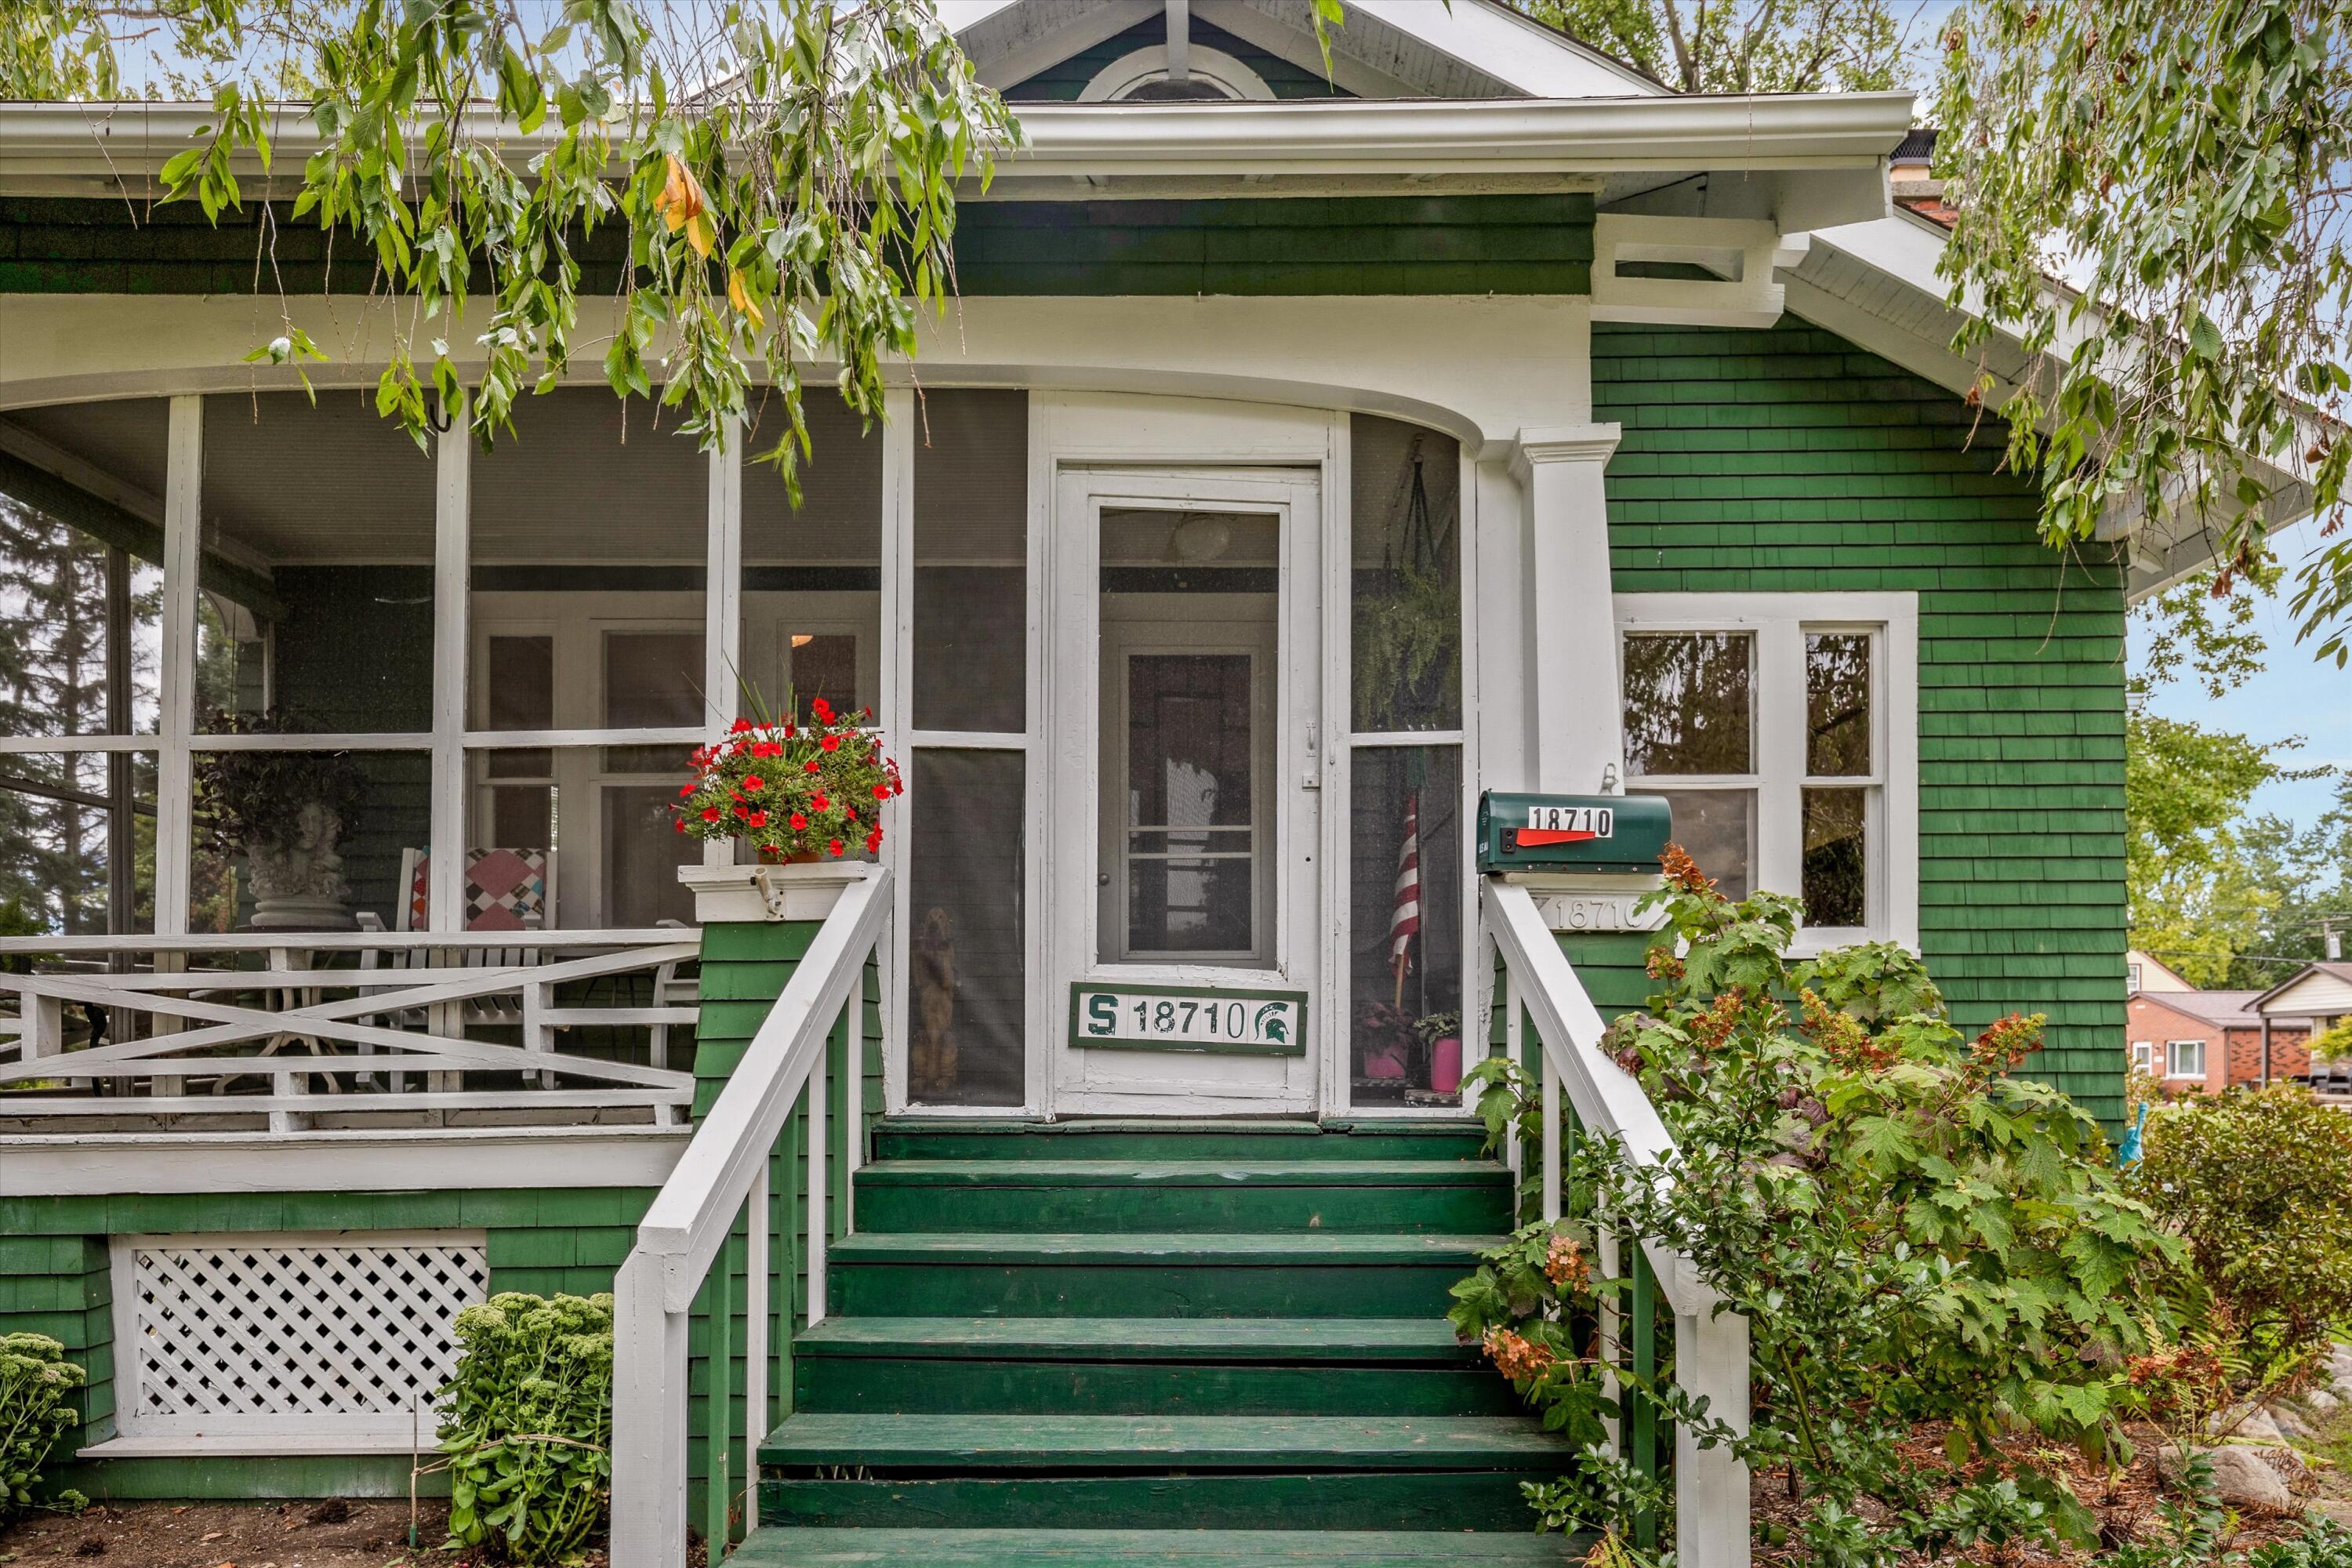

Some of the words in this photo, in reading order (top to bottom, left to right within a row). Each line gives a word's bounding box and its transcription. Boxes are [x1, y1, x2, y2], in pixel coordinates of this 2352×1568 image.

[1534, 808, 1611, 837] 18710
[1555, 900, 1643, 929] 18710
[1088, 994, 1119, 1036] S
[1133, 1000, 1245, 1039] 18710
